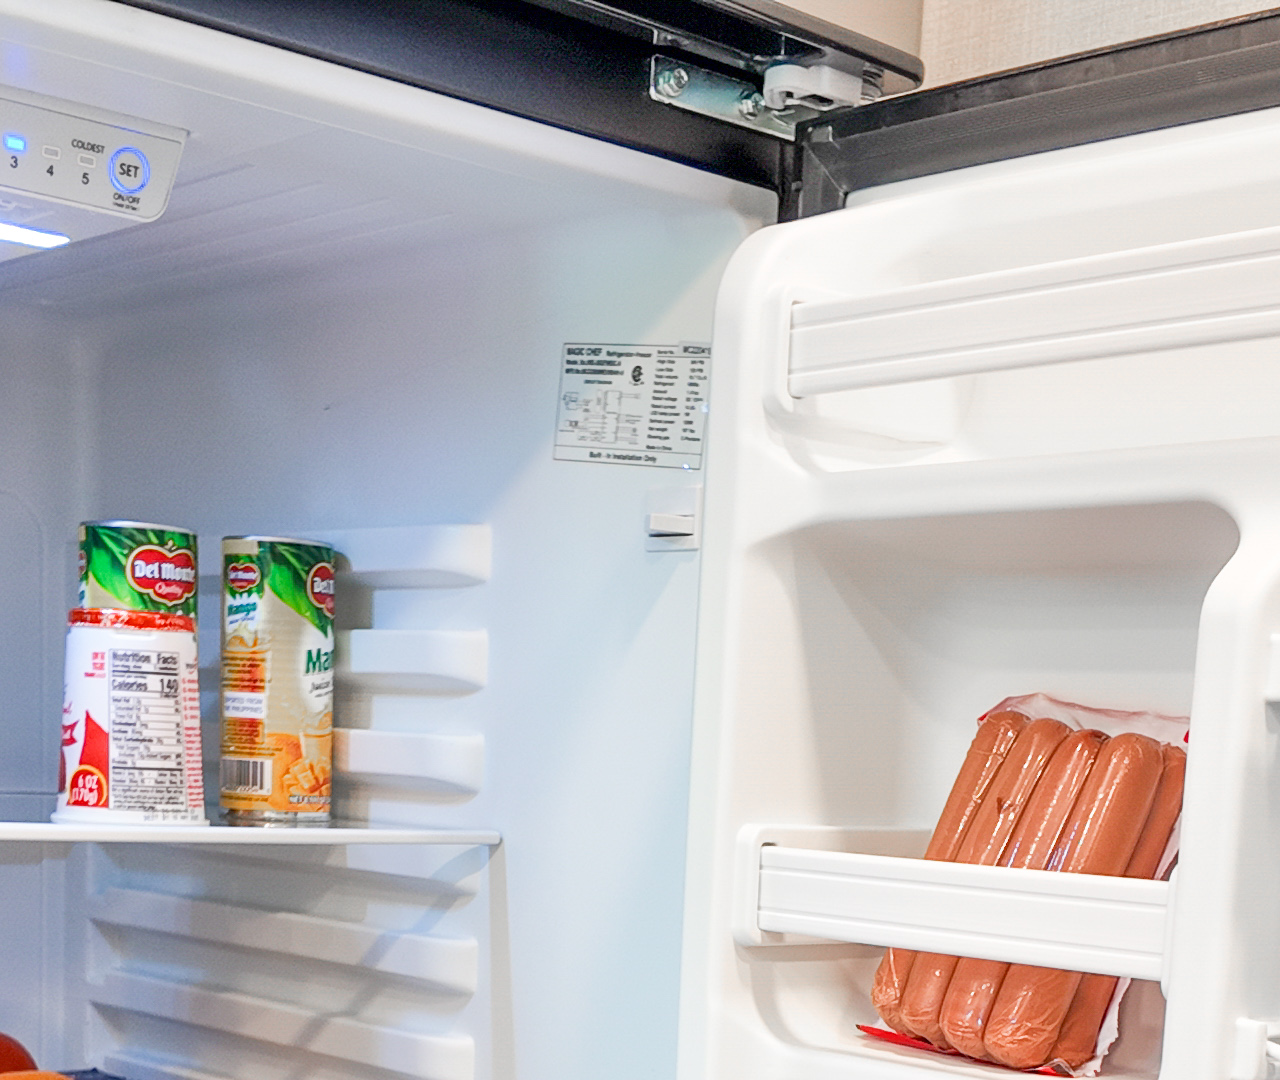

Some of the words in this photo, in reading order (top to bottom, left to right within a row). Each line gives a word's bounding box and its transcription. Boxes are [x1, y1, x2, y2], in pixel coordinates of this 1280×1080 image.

[71, 138, 105, 154] COLDEST
[10, 155, 19, 168] 3
[46, 164, 55, 176] 4
[81, 172, 90, 185] 5
[119, 162, 140, 178] SET
[111, 192, 141, 204] ON/OFF
[134, 559, 159, 578] Del
[78, 774, 84, 788] 6
[85, 774, 99, 789] OZ
